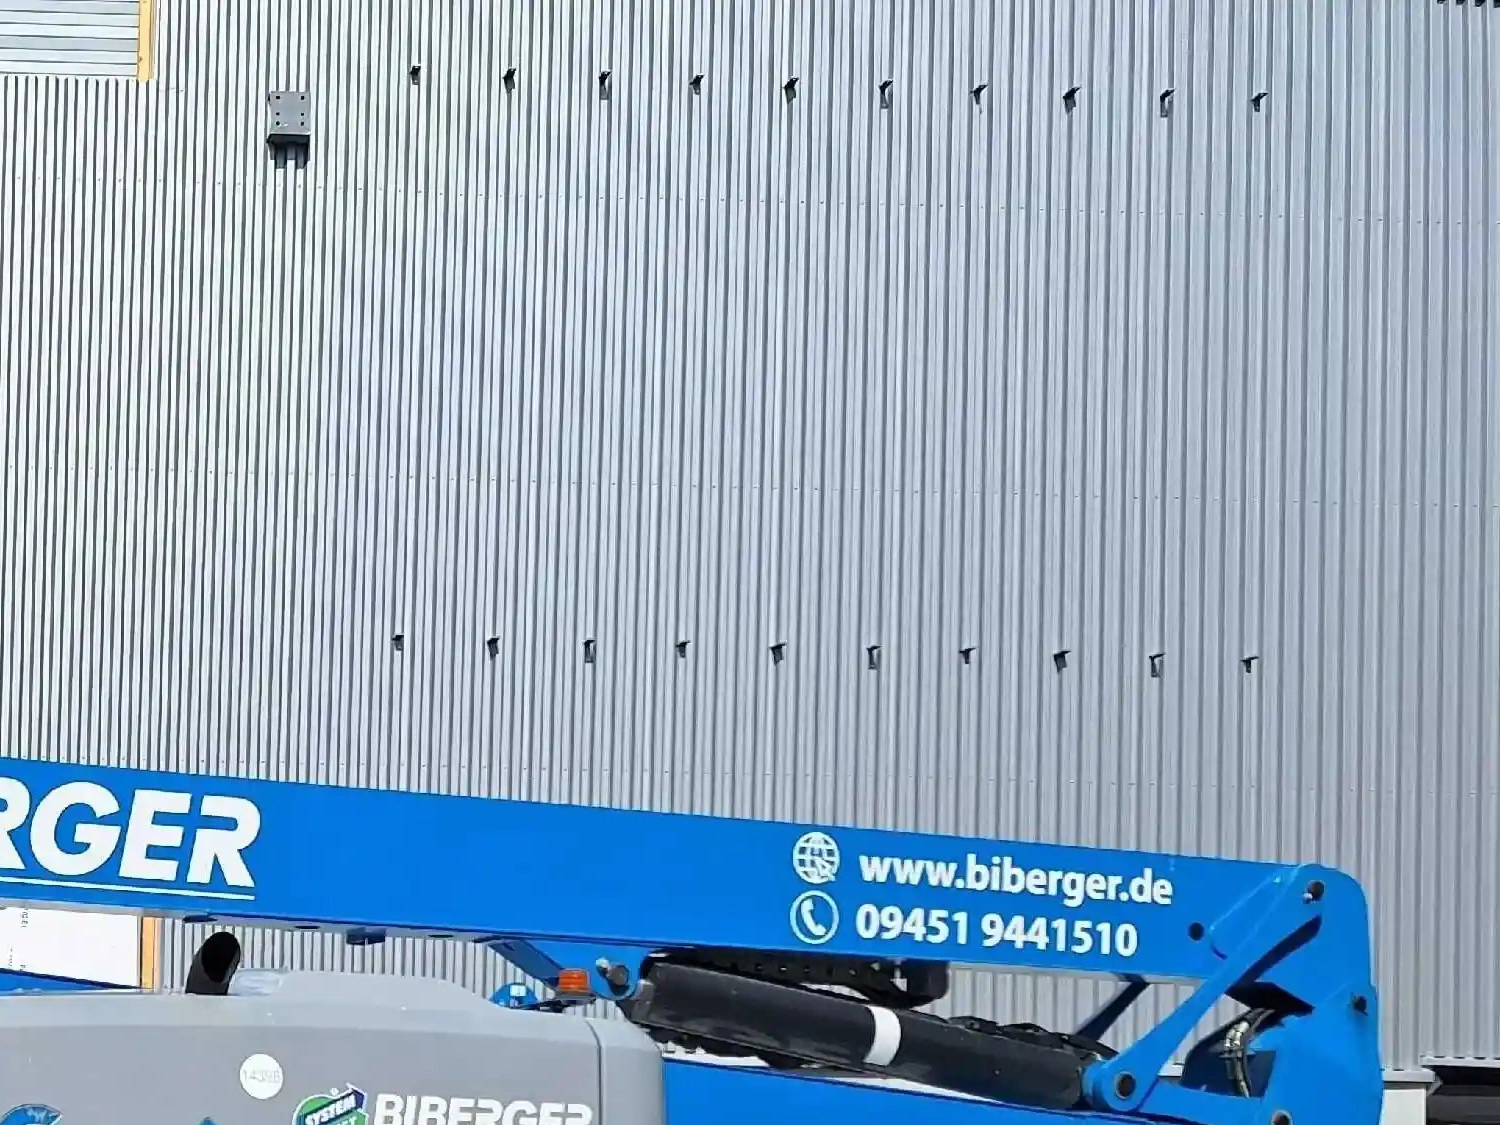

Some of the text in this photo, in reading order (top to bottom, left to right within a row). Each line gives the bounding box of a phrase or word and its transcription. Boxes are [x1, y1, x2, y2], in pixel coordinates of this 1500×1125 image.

[858, 853, 1174, 907] www.biberger.de
[855, 903, 1139, 957] 09451 9441510
